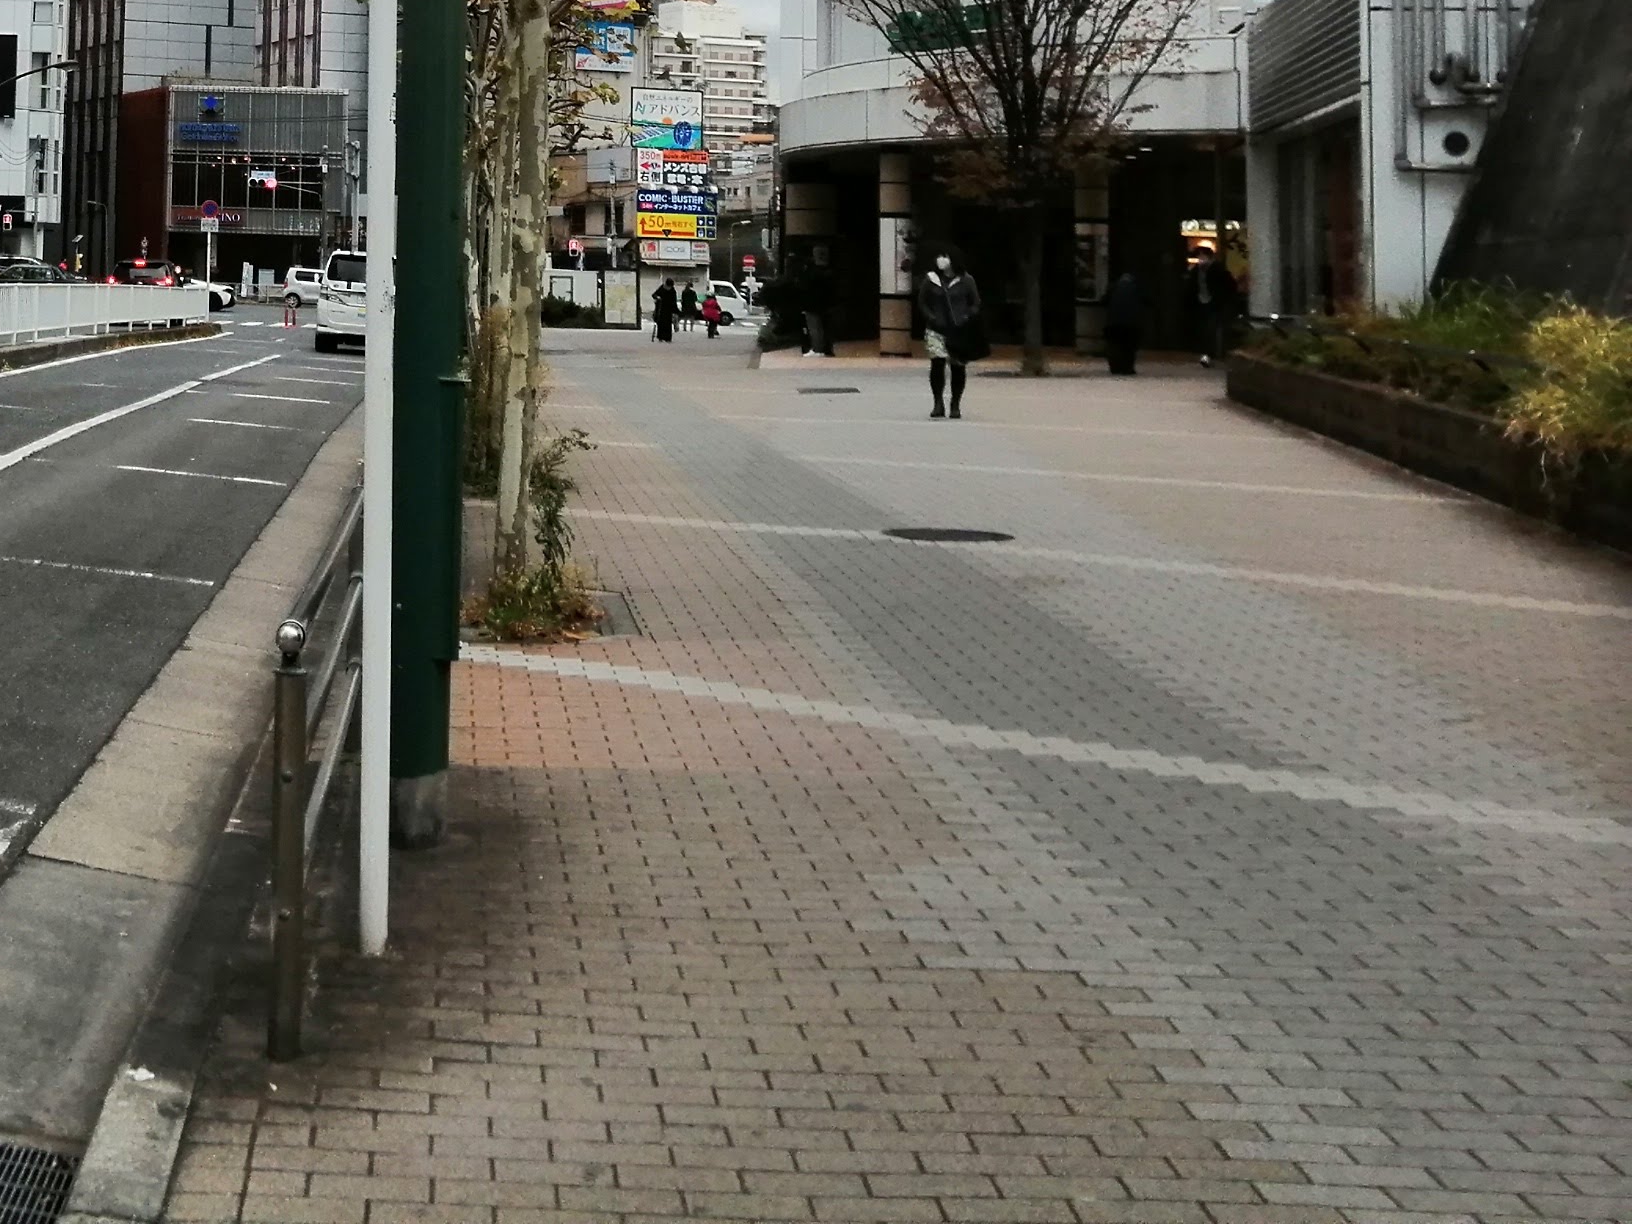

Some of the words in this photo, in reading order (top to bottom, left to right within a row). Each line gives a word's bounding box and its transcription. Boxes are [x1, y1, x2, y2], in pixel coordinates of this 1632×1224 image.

[649, 104, 700, 116] アドバンス
